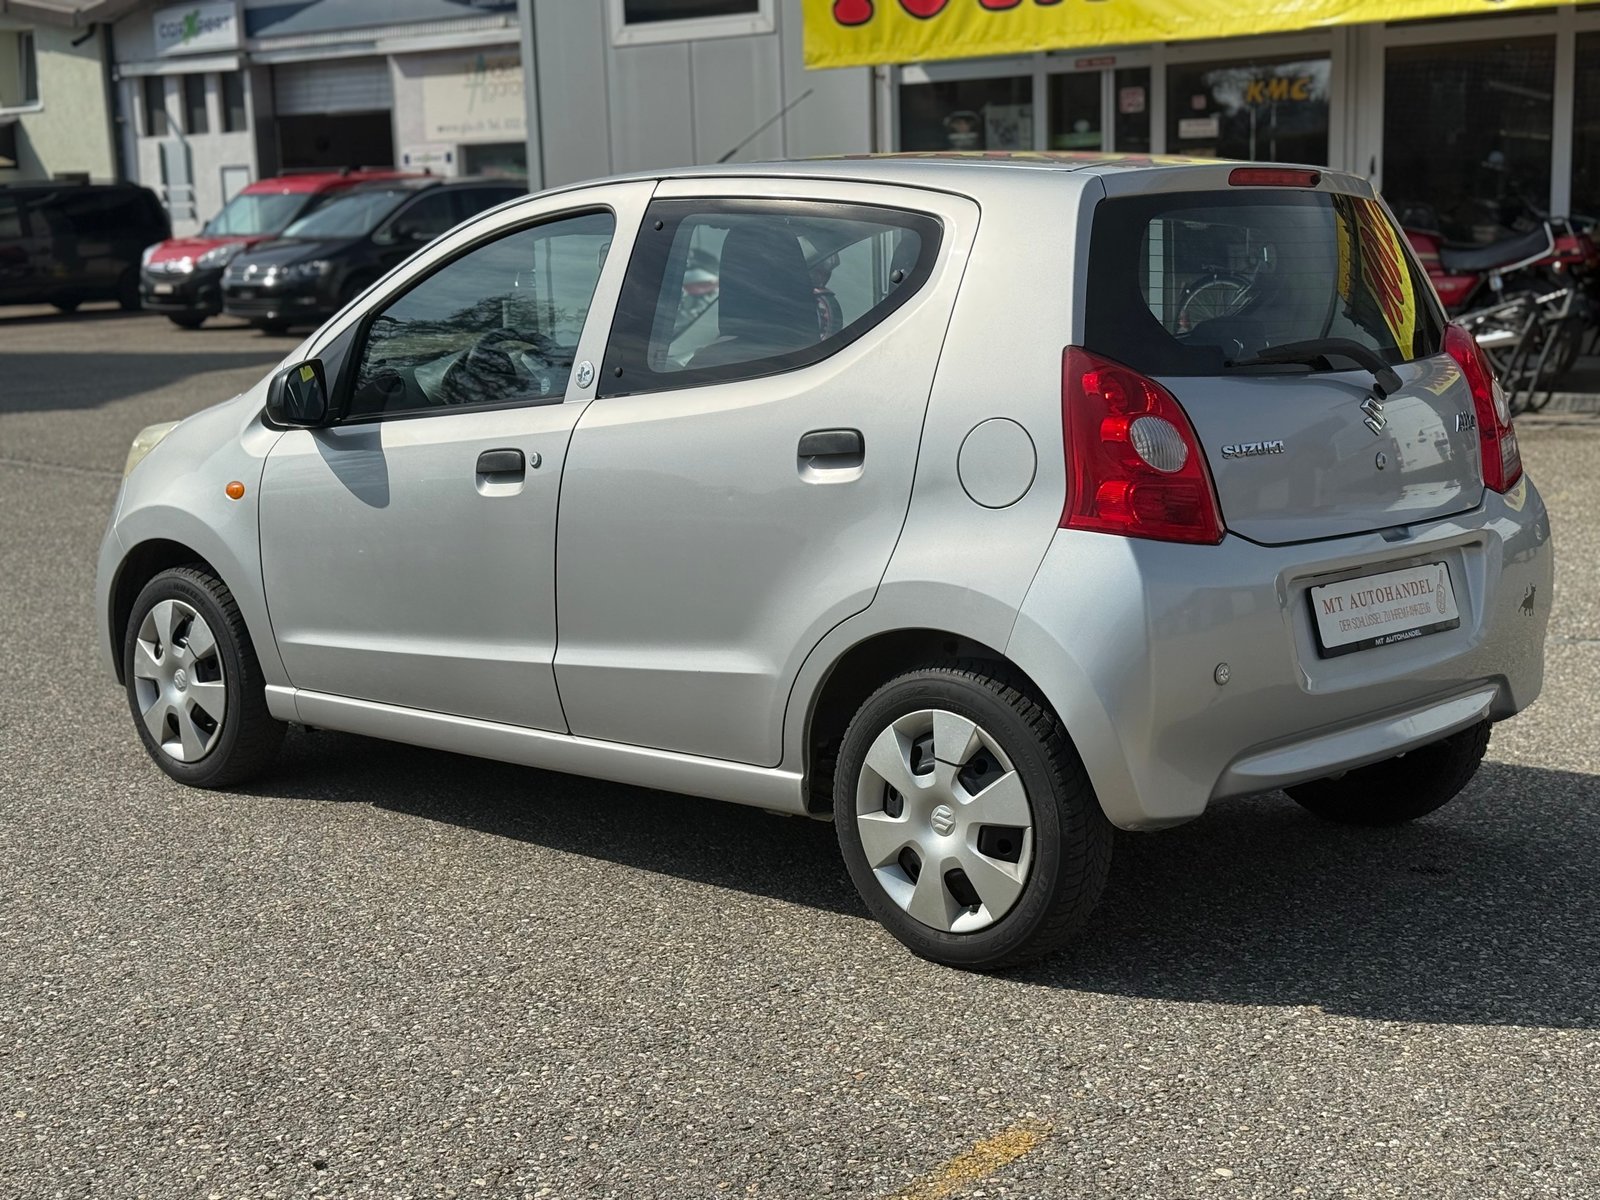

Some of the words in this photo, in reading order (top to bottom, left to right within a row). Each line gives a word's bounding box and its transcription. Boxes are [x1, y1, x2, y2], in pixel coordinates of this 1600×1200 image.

[1247, 76, 1312, 104] KMC
[1221, 440, 1285, 460] SUZUKI
[1322, 596, 1344, 615] MT
[1350, 578, 1434, 610] AUTOHANDEL
[1338, 619, 1352, 633] DER
[1375, 637, 1385, 646] MT
[1385, 629, 1422, 644] AUTOHANDEL
